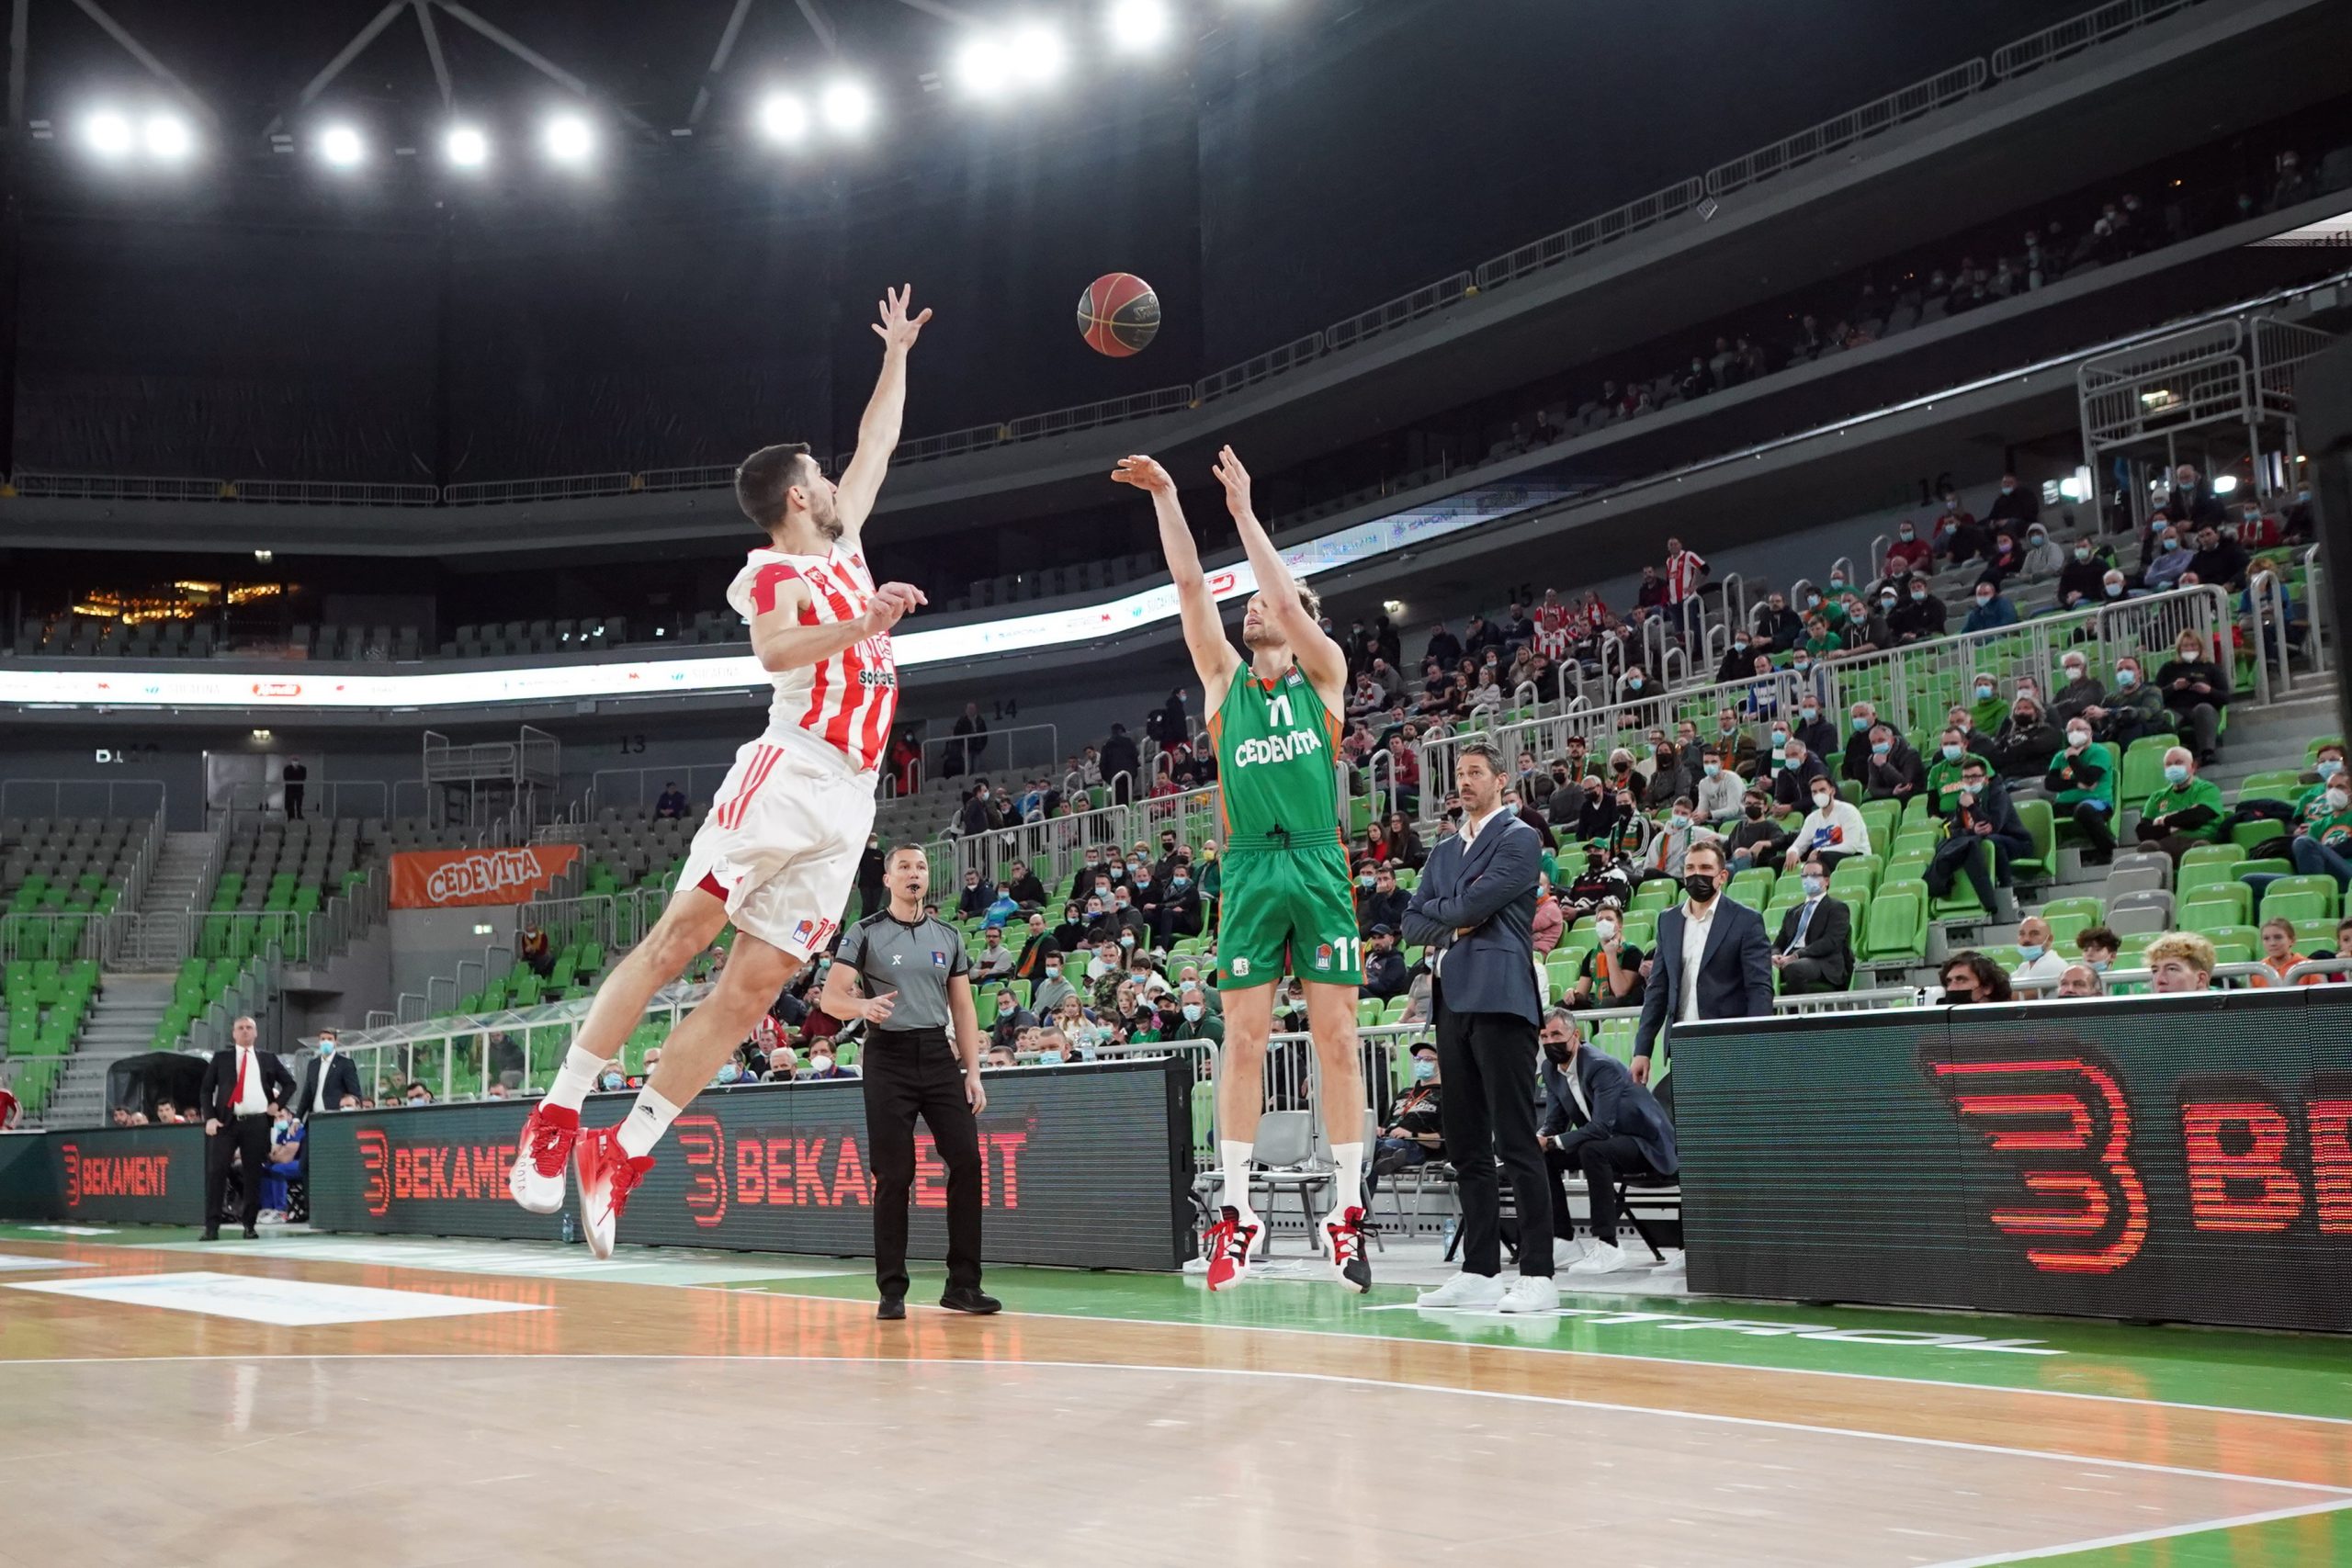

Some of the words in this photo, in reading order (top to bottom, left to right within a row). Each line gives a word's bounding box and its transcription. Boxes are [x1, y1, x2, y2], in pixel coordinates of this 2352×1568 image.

[1508, 582, 1533, 608] 15
[993, 698, 1018, 720] 14
[620, 735, 646, 754] 13
[1235, 728, 1322, 767] CEDEVITA
[427, 850, 542, 901] CEDEVITA
[1333, 936, 1361, 972] 11
[83, 1156, 169, 1196] BEKAMENT
[736, 1134, 1028, 1209] BEKAET
